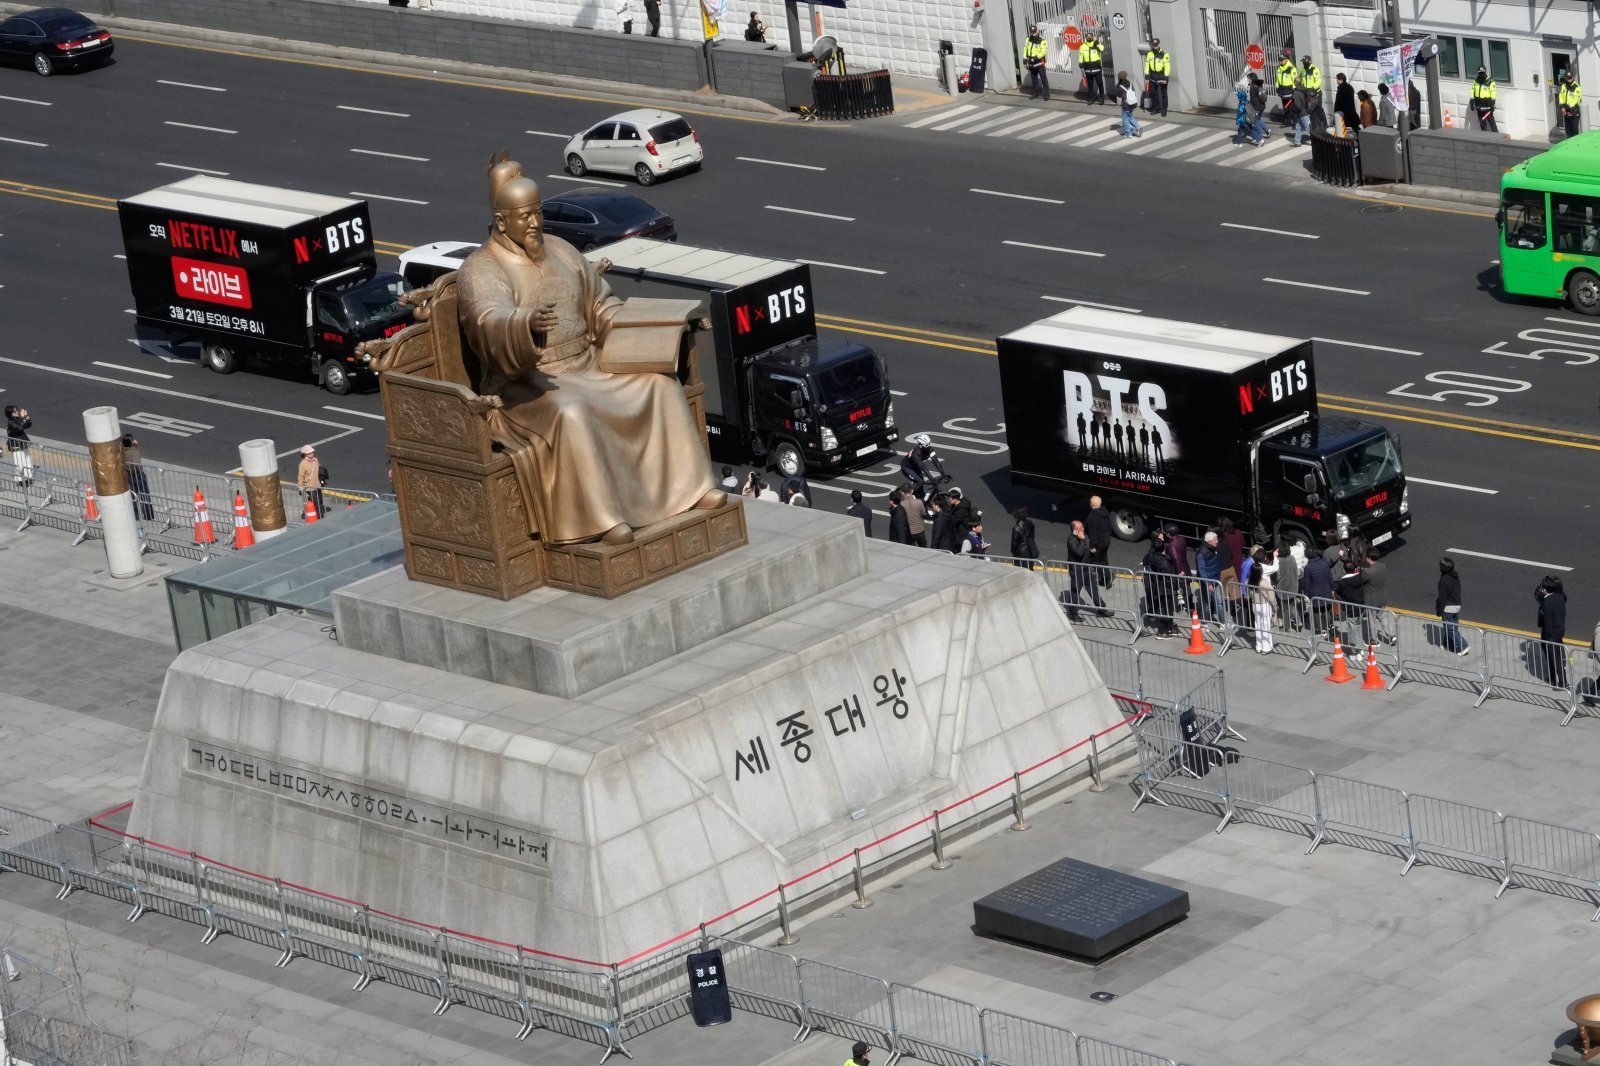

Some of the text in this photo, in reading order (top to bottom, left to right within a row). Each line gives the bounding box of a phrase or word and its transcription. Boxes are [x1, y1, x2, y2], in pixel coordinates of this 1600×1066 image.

[1065, 34, 1081, 44] STOP
[1246, 51, 1264, 63] STOP
[149, 220, 259, 259] 오직 NETFLIX 에서
[293, 235, 310, 264] N
[325, 217, 365, 254] BTS
[190, 266, 243, 299] 라이브
[169, 305, 265, 335] 3월 21일 토요일 오후 8시
[735, 304, 751, 335] N
[767, 285, 806, 324] BTS
[323, 332, 344, 344] NETFLIX
[1481, 328, 1600, 365] 50
[1239, 383, 1254, 416] N
[1270, 359, 1307, 403] BTS
[1386, 370, 1533, 407] 50
[850, 407, 872, 422] NETFLIX
[1063, 369, 1173, 460] BTS
[1082, 462, 1095, 472] 컴백
[1096, 465, 1117, 477] 라이브
[1125, 471, 1166, 486] ARIRANG
[1365, 492, 1388, 508] NETFLIX
[735, 668, 909, 781] 세종대왕
[696, 965, 717, 978] 경찰
[697, 979, 719, 988] POLICE
